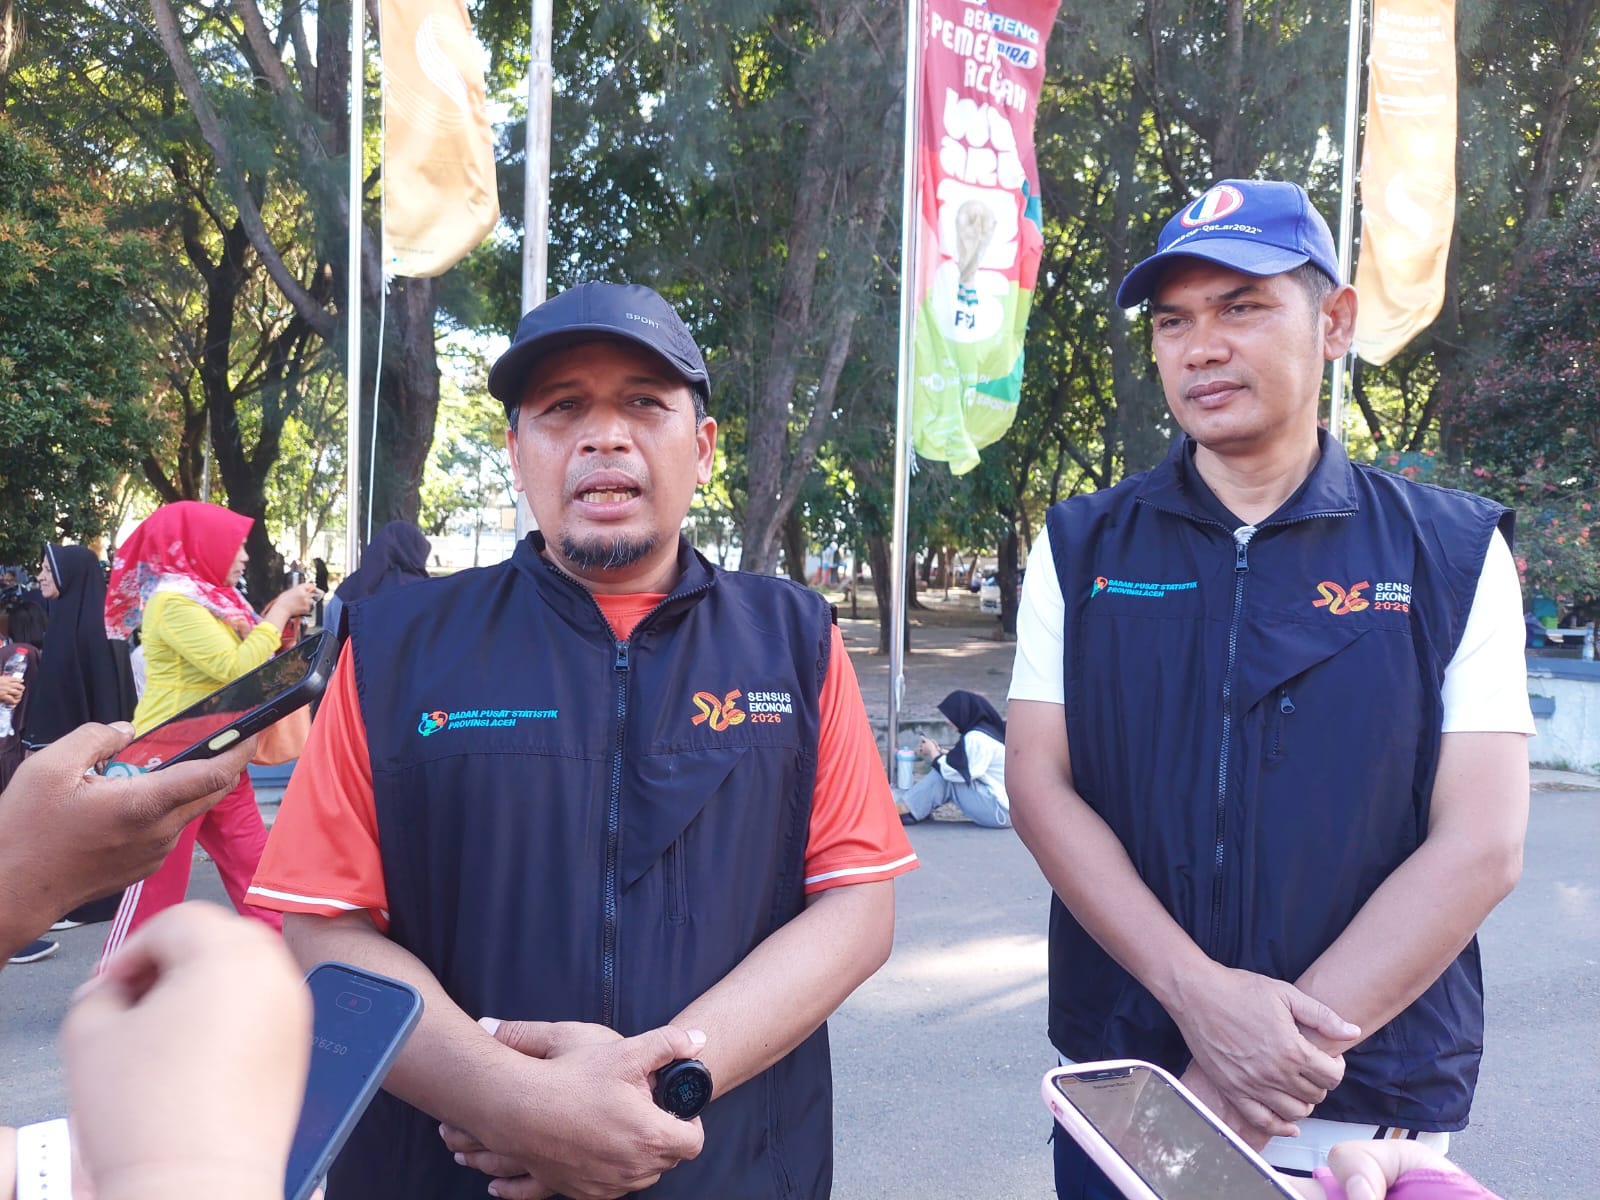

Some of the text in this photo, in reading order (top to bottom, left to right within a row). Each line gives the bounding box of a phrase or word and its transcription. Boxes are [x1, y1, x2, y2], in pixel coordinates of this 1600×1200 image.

[1374, 601, 1409, 612] 2026
[747, 691, 791, 703] SENSUS
[749, 702, 793, 714] EKONOMI
[448, 710, 559, 721] BADAN PUSAT STATISTIK
[750, 713, 782, 723] 2026
